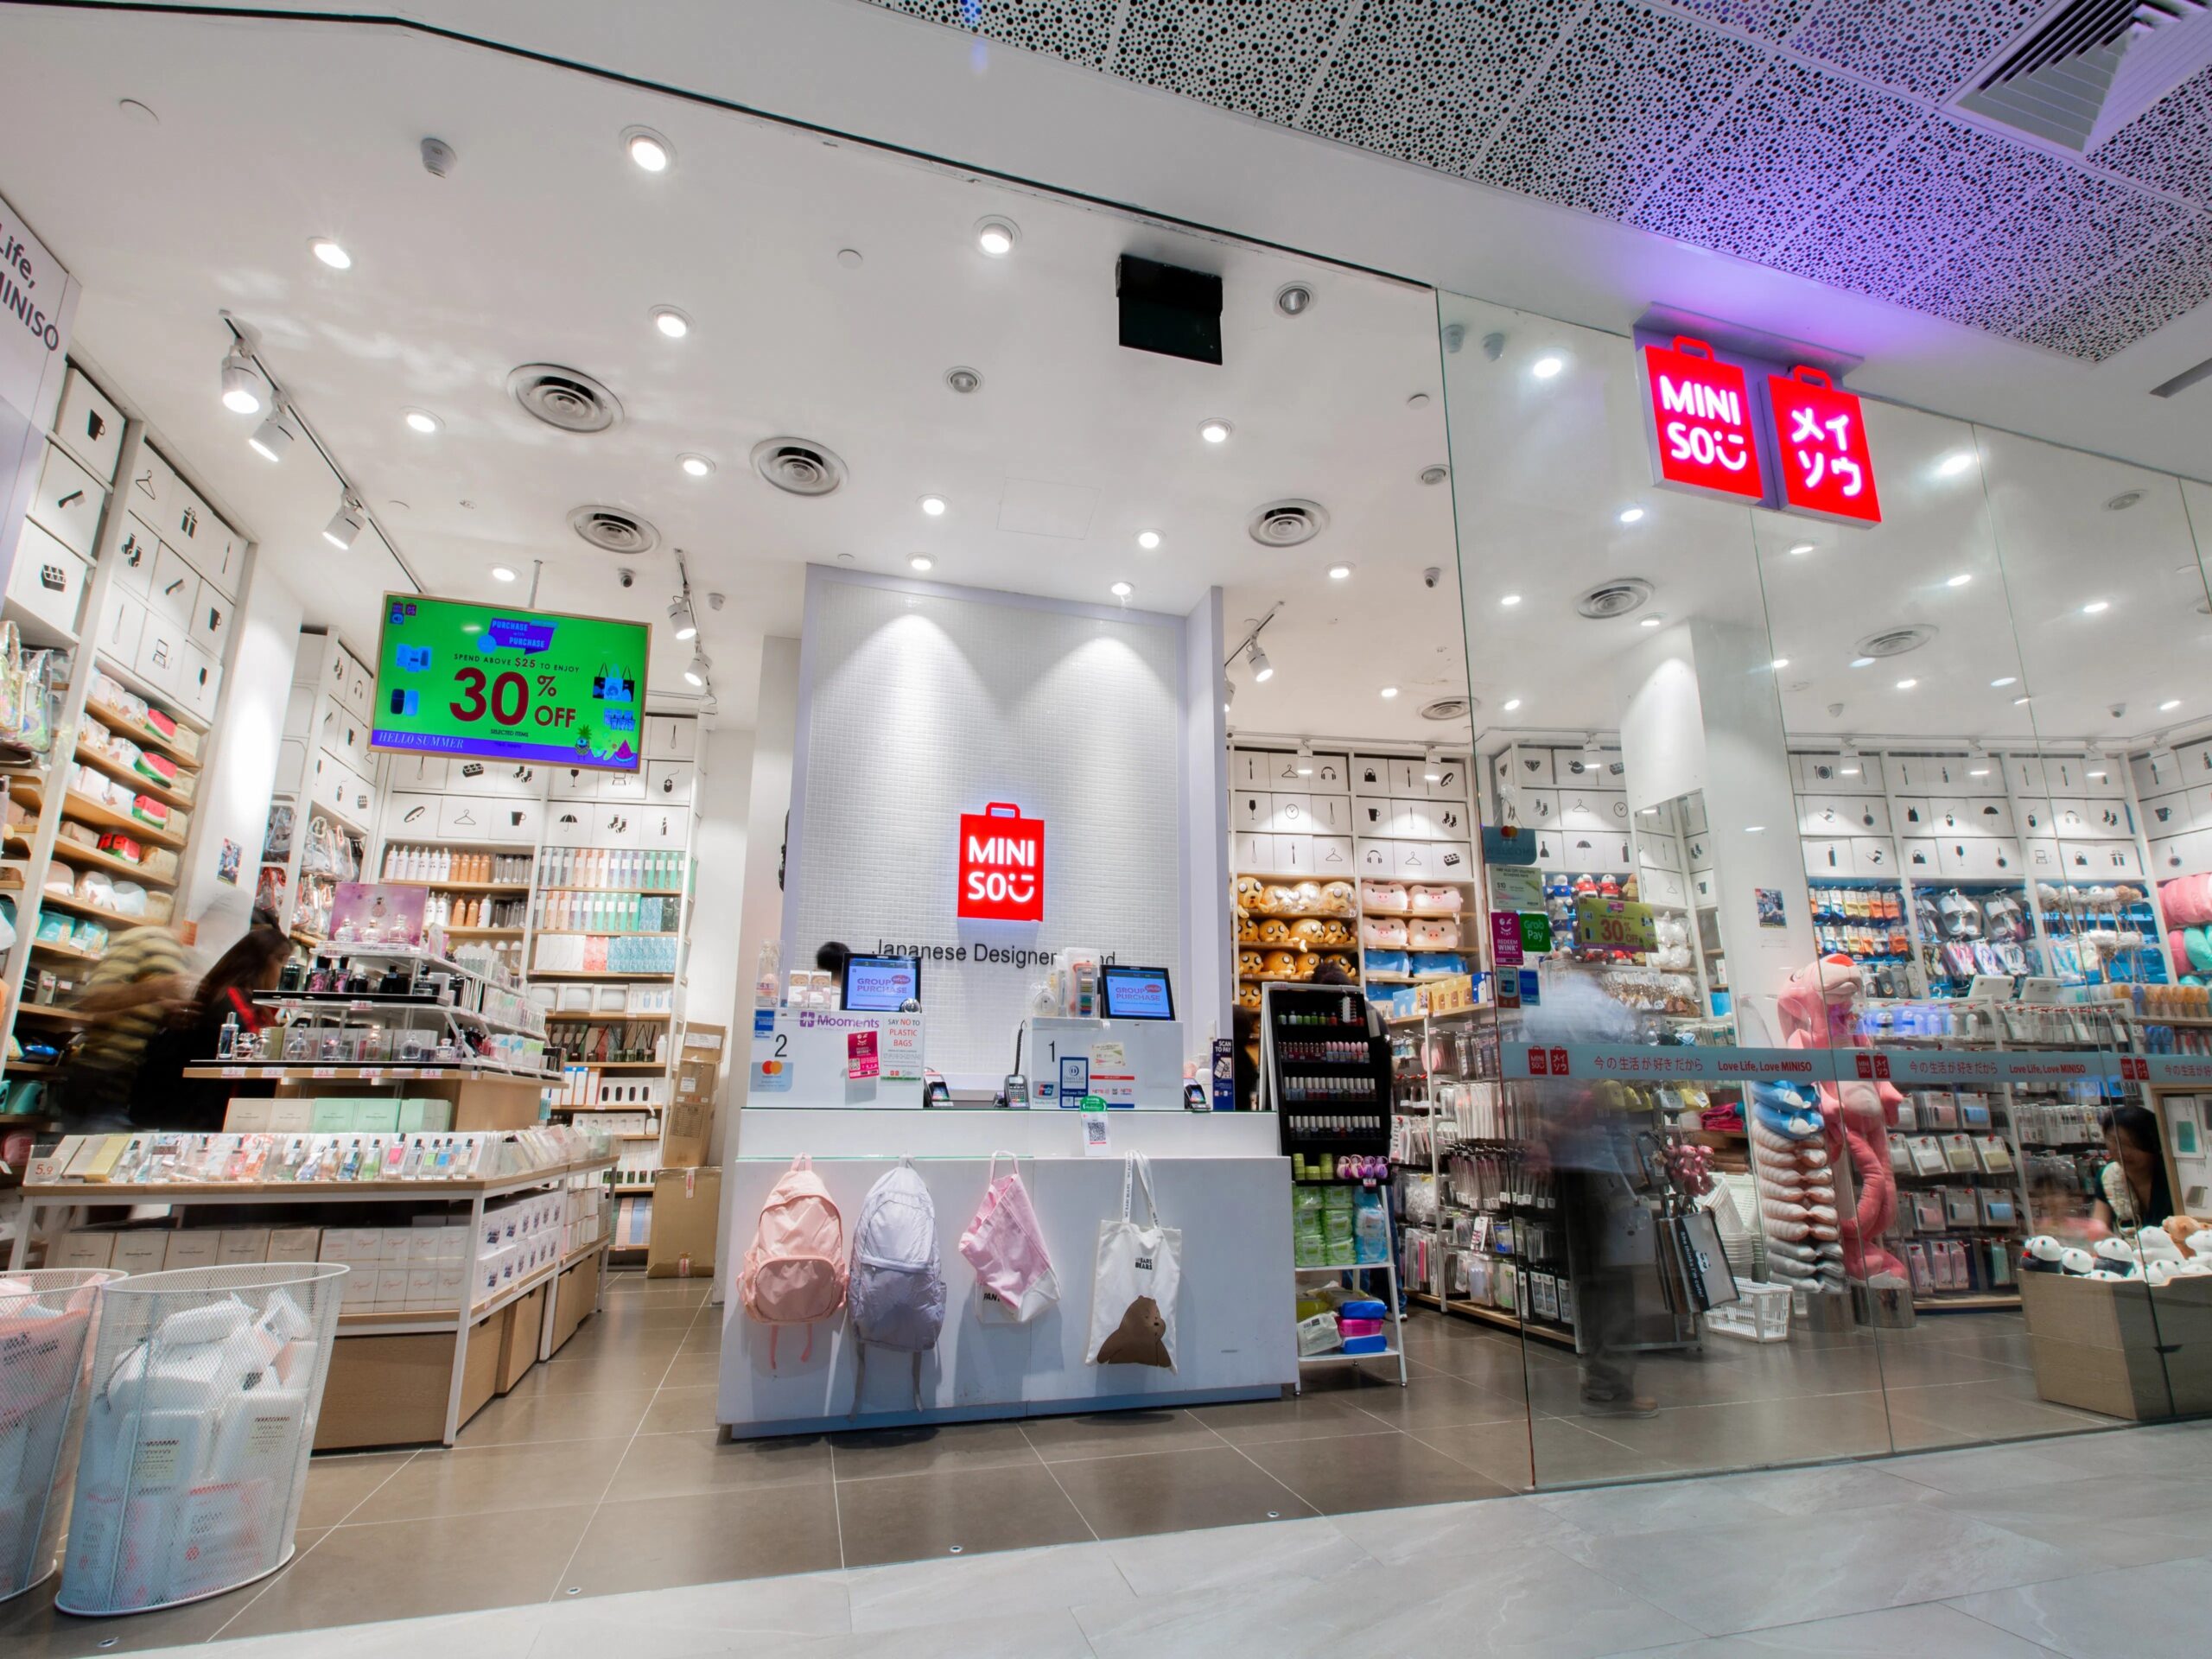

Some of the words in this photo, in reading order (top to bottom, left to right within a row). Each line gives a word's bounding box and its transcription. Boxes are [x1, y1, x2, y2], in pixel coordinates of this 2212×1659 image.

[0, 225, 35, 289] ife,
[1659, 375, 1741, 425] MINI
[1791, 407, 1849, 452] メイ
[1797, 449, 1862, 497] ソウ
[492, 620, 528, 632] PURCHASE
[509, 637, 544, 648] PURCHASE
[454, 653, 480, 662] SPEND
[484, 657, 512, 665] ABOVE
[515, 657, 536, 668] $25
[554, 664, 580, 673] ENJOY
[449, 667, 529, 726] 30
[535, 705, 576, 728] OFF
[378, 732, 414, 744] HELLO
[416, 735, 464, 749] SUMMER
[968, 836, 1035, 867] MINI
[1528, 930, 1543, 942] Pay
[872, 939, 967, 961] Japanese
[974, 944, 1057, 969] Designer
[856, 985, 907, 994] PURCHASE
[817, 1014, 880, 1028] Mooments
[774, 1033, 788, 1058] 2
[1048, 1040, 1055, 1063] 1
[1718, 1060, 1738, 1071] Love
[1739, 1060, 1758, 1072] Life,
[1759, 1061, 1779, 1071] Love
[1781, 1061, 1812, 1071] MINISO
[2009, 1064, 2026, 1073] Love
[2043, 1064, 2059, 1073] Love
[2060, 1064, 2086, 1073] MINISO
[35, 1163, 54, 1175] 5.9
[1135, 1262, 1153, 1270] BEARS
[983, 1293, 1000, 1302] PAN
